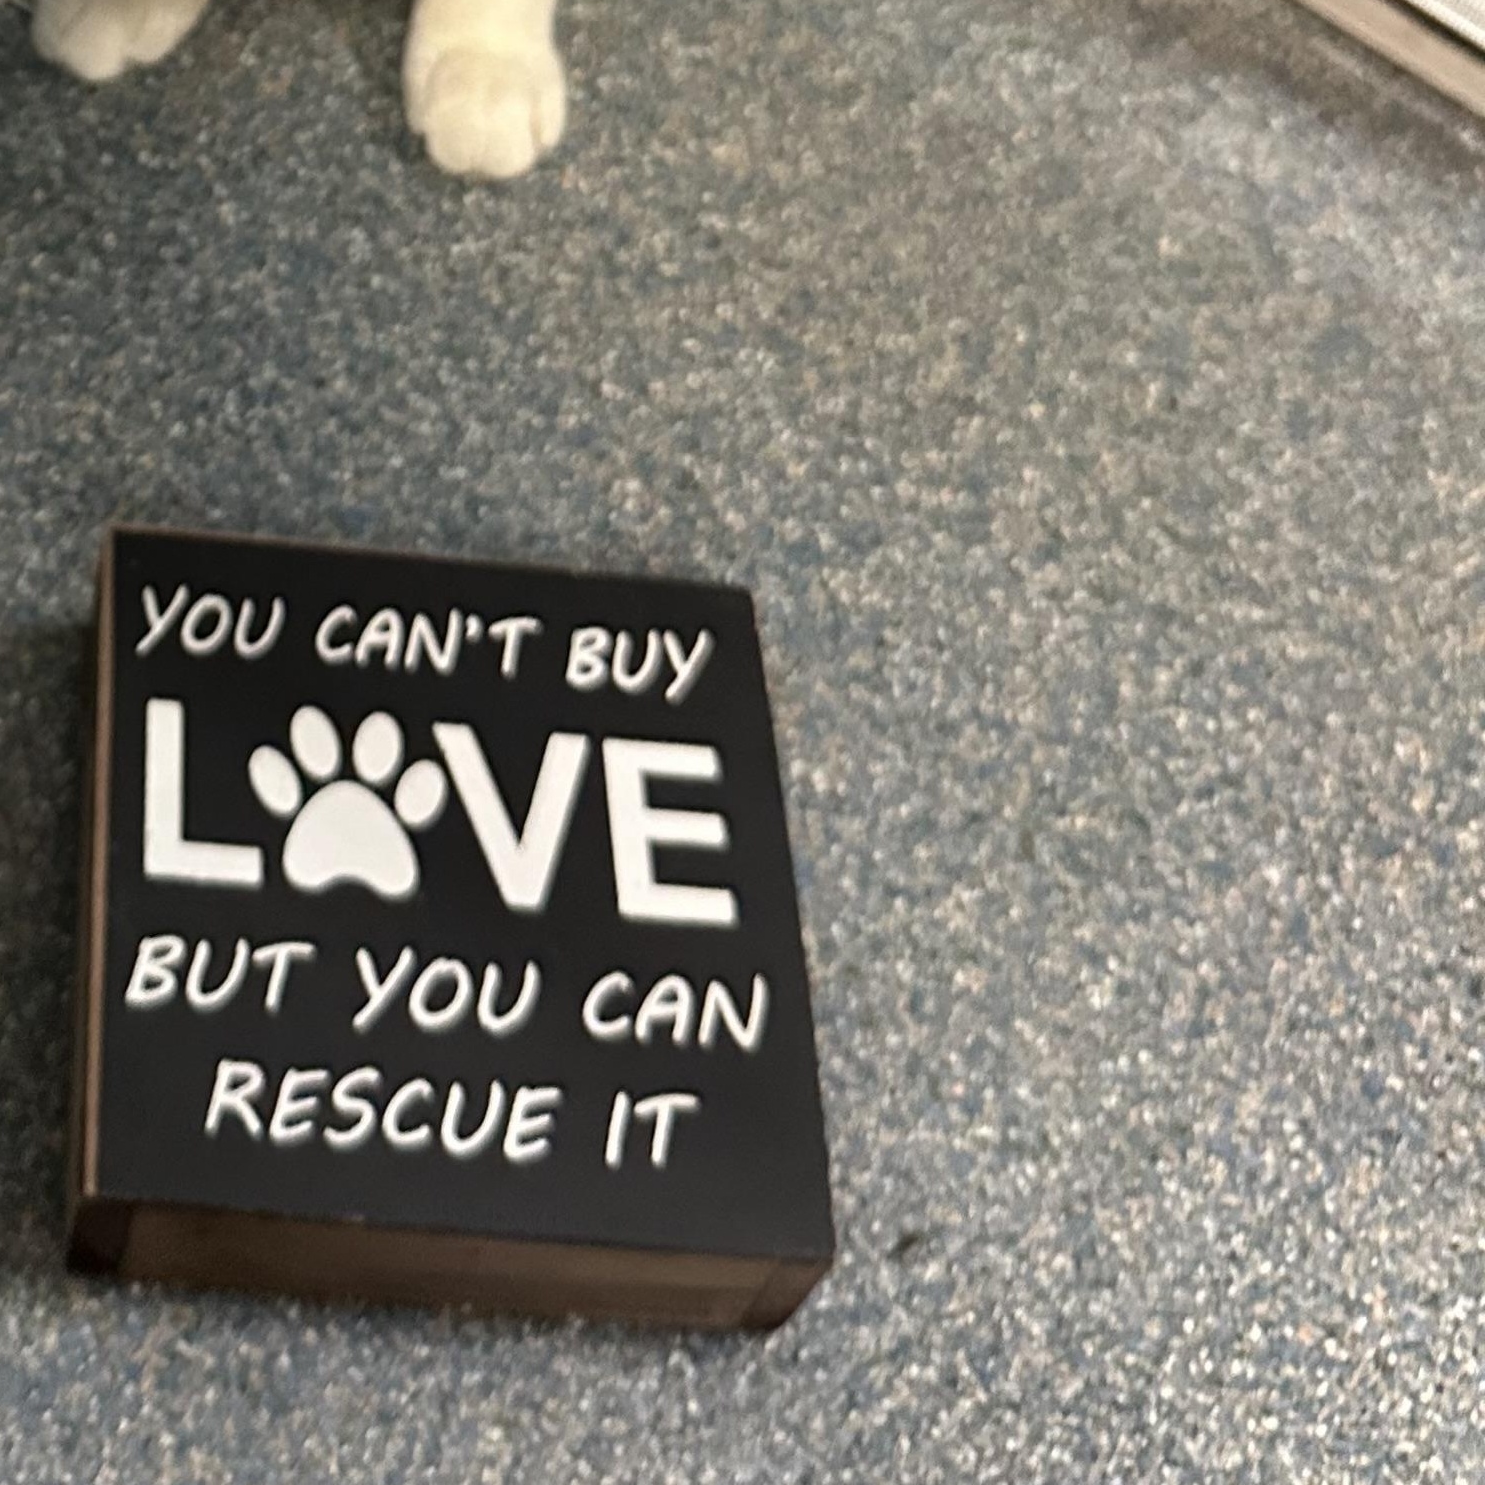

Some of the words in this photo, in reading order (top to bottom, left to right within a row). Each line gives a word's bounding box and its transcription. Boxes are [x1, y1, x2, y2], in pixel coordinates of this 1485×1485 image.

[136, 585, 284, 657] YOU
[315, 605, 540, 682] CAN'T
[564, 626, 715, 703] BUY
[143, 698, 738, 928] LVE
[125, 934, 315, 1011] BUT
[352, 946, 540, 1035] YOU
[581, 970, 768, 1053] CAN
[203, 1058, 563, 1163] RESCUE
[604, 1090, 699, 1169] IT
